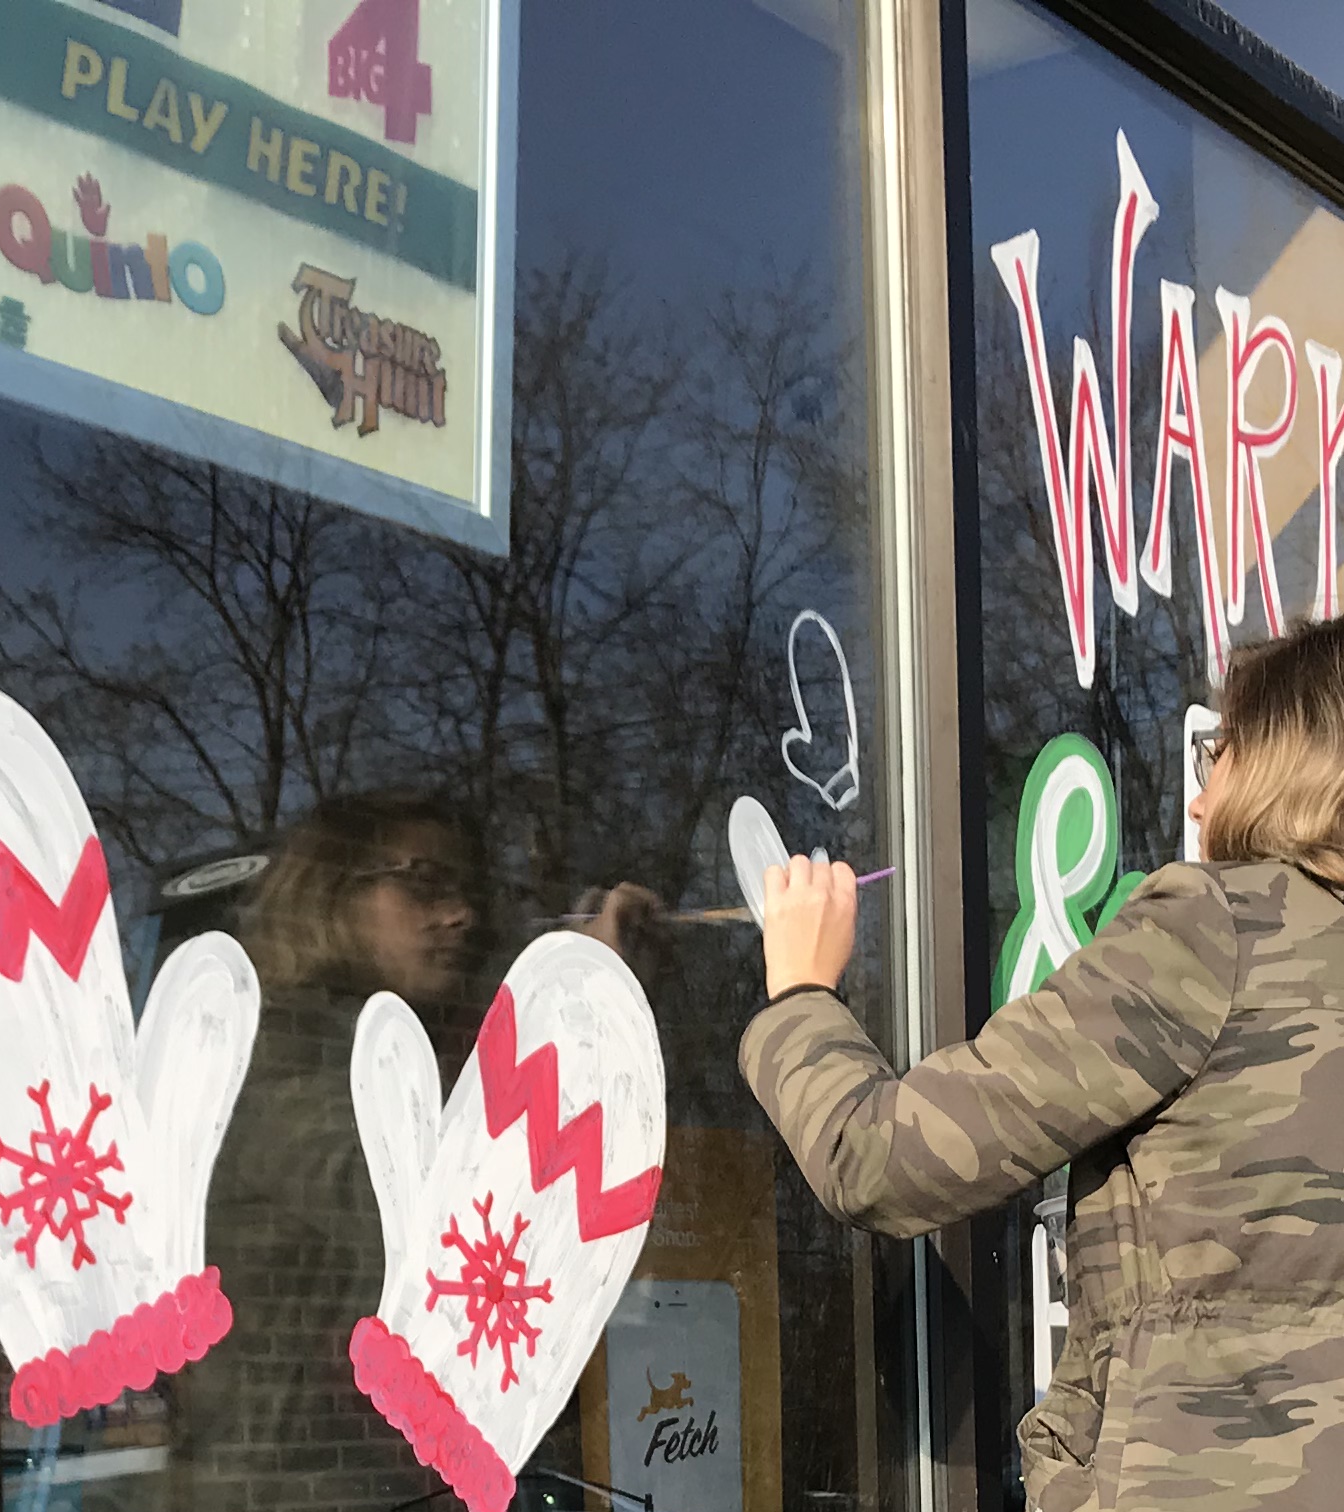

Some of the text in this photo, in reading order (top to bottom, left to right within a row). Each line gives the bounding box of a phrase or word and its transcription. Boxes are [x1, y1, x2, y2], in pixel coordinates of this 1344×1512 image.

[60, 36, 409, 233] PLAY HERE!
[291, 261, 441, 375] Treasure
[331, 348, 447, 438] Hunt
[643, 1409, 720, 1468] Fetch
